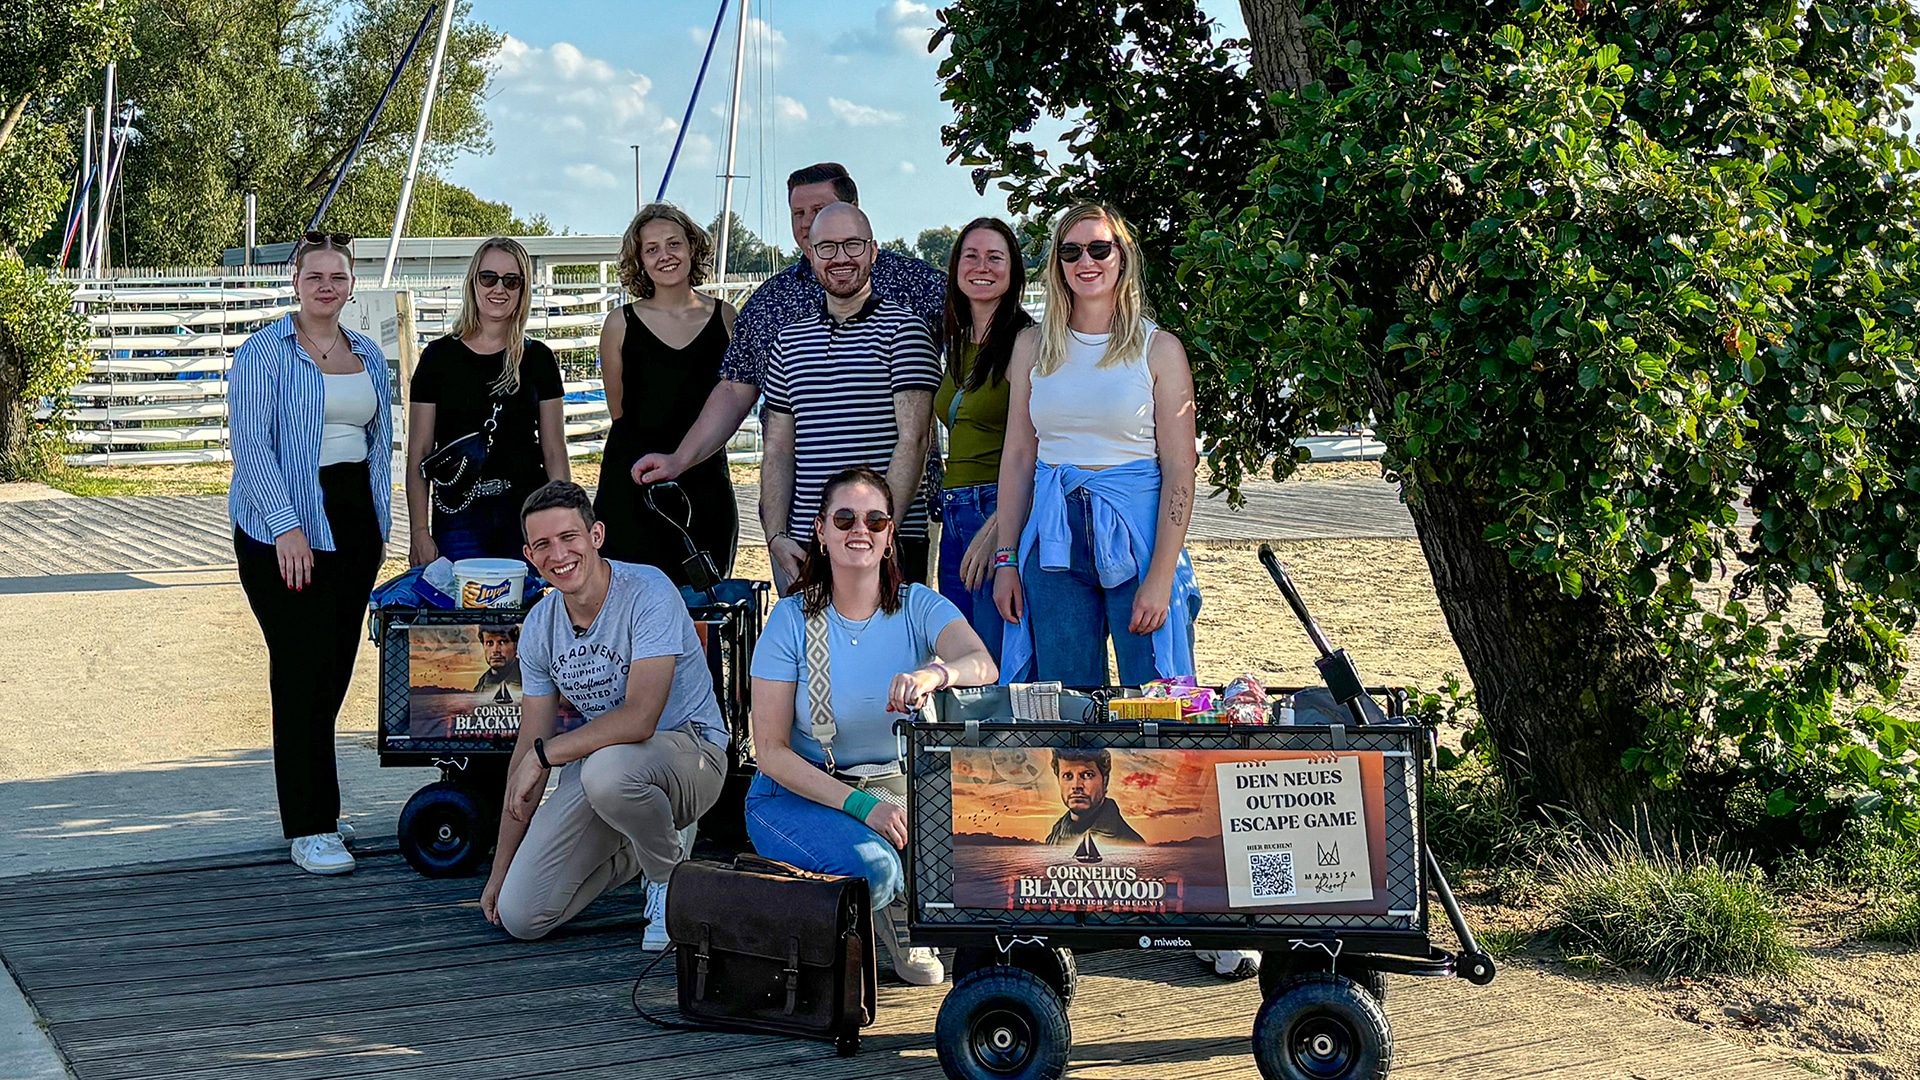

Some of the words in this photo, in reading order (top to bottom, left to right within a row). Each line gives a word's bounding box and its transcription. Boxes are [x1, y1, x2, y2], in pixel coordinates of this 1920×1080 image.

[474, 706, 522, 717] CORNELI
[455, 716, 522, 730] BLACKW
[1236, 773, 1279, 789] DEIN
[1284, 770, 1343, 787] NEUES
[1246, 791, 1337, 810] OUTDOOR
[1230, 814, 1300, 833] ESCAPE
[1303, 811, 1357, 829] GAME
[1046, 866, 1137, 880] CORNELIUS
[1305, 871, 1356, 880] MARISSA
[1020, 879, 1164, 899] BLACKWOOD
[1154, 936, 1192, 947] miweba
